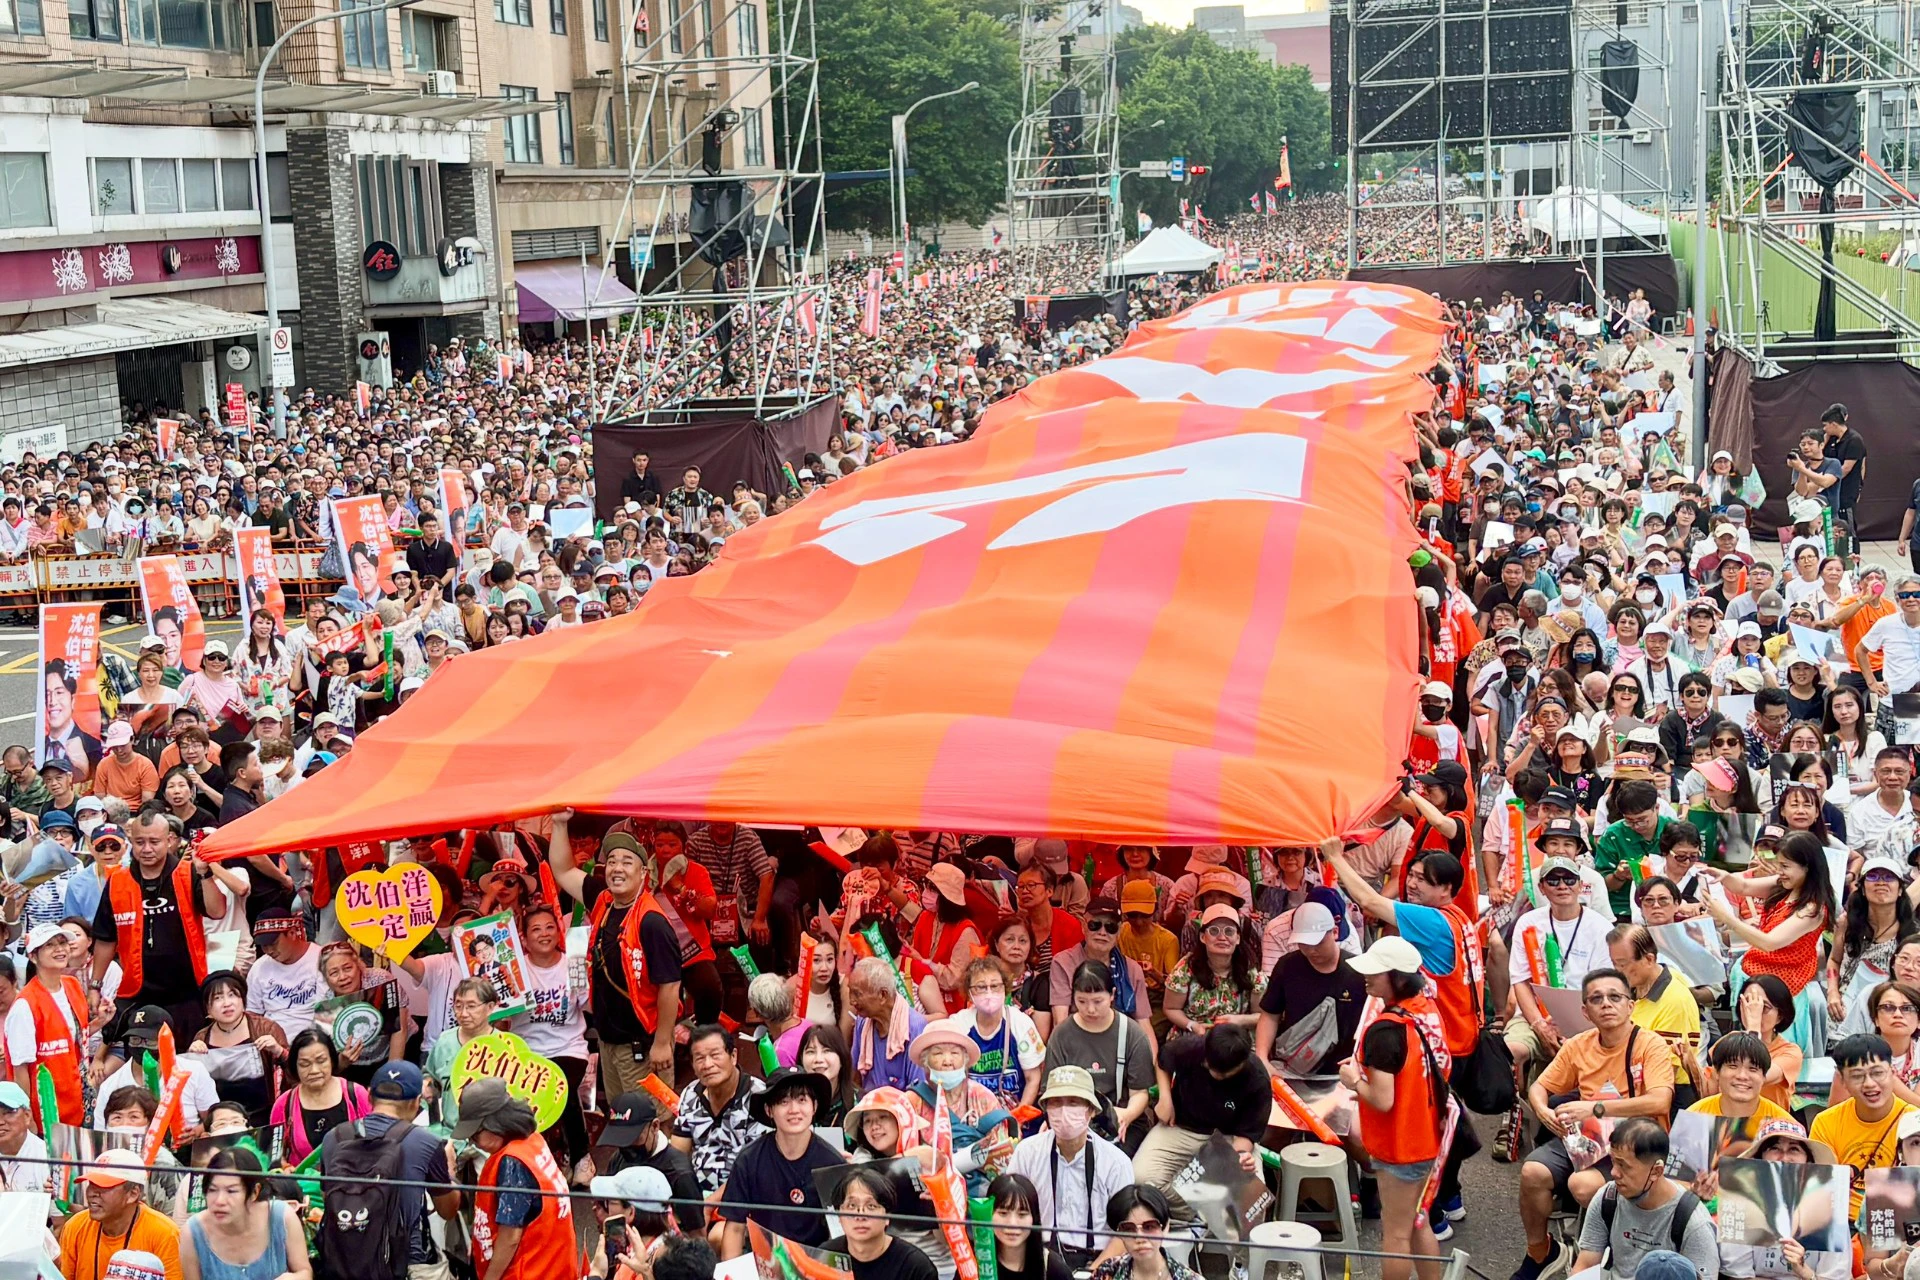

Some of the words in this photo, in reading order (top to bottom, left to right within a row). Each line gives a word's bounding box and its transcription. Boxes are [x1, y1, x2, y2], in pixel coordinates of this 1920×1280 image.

[56, 561, 134, 579] 禁止停車
[63, 613, 86, 681] 沈伯洋
[345, 869, 429, 909] 沈伯洋
[350, 898, 436, 942] 一定贏
[534, 989, 561, 1005] 台北
[465, 1043, 551, 1094] 沈伯洋
[1870, 1209, 1884, 1250] 沈伯洋
